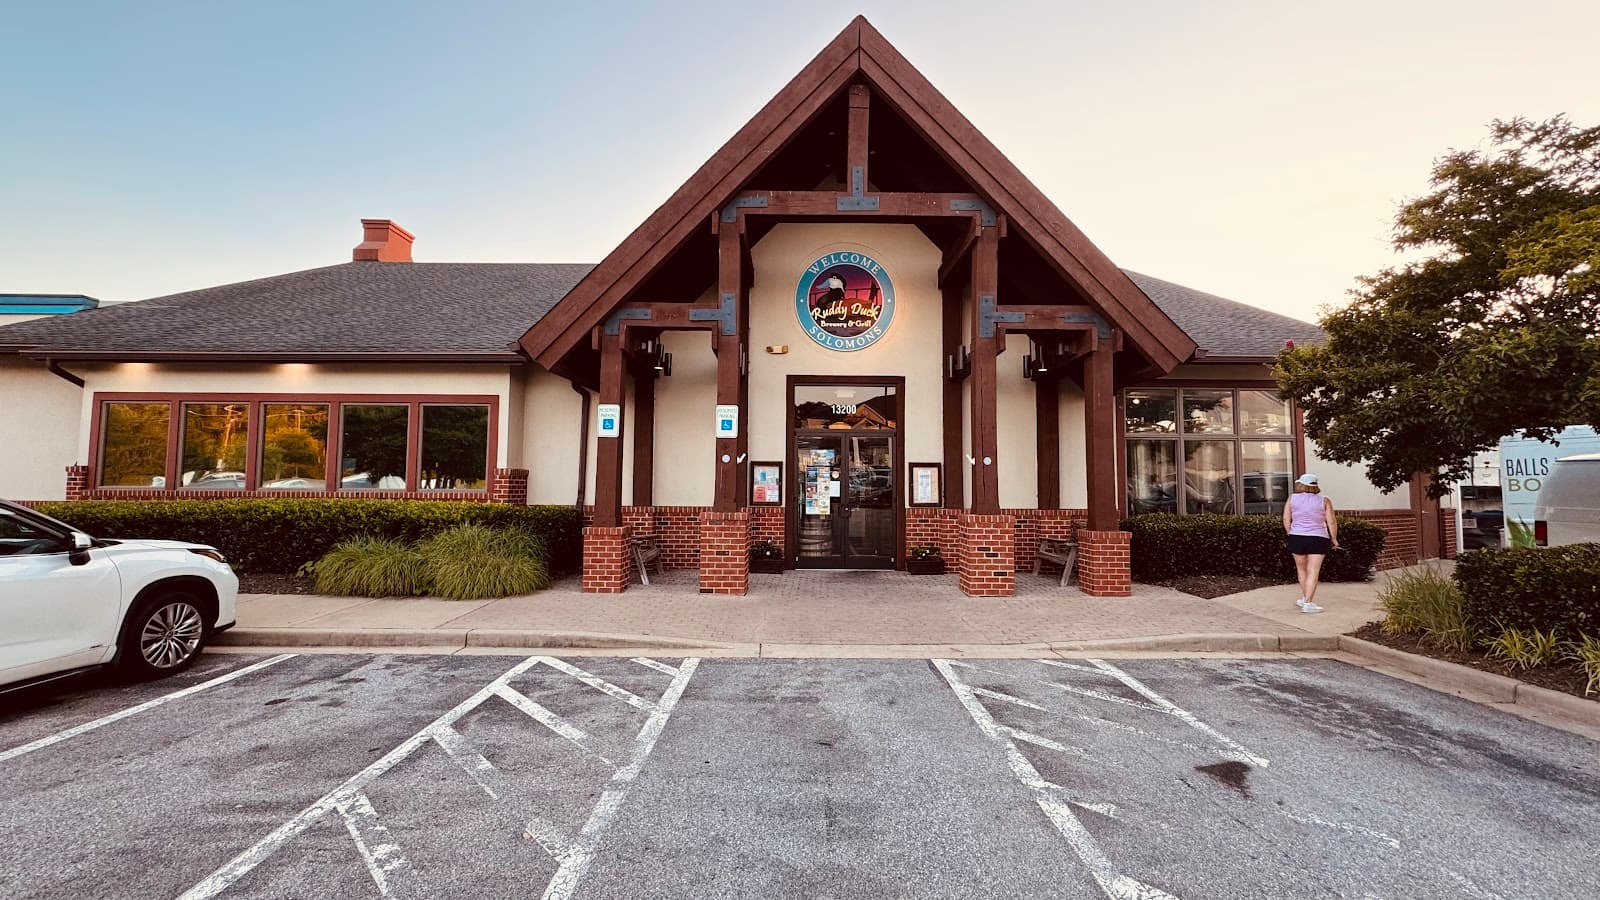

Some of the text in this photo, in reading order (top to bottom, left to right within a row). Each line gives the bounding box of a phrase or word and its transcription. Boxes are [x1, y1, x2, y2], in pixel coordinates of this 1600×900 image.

[809, 253, 881, 274] WELCOME
[811, 300, 880, 320] Ruddy Duck
[820, 320, 847, 328] Brewery
[809, 326, 882, 348] SOLOMONS
[831, 404, 857, 414] 13200
[1506, 457, 1549, 476] BALLS
